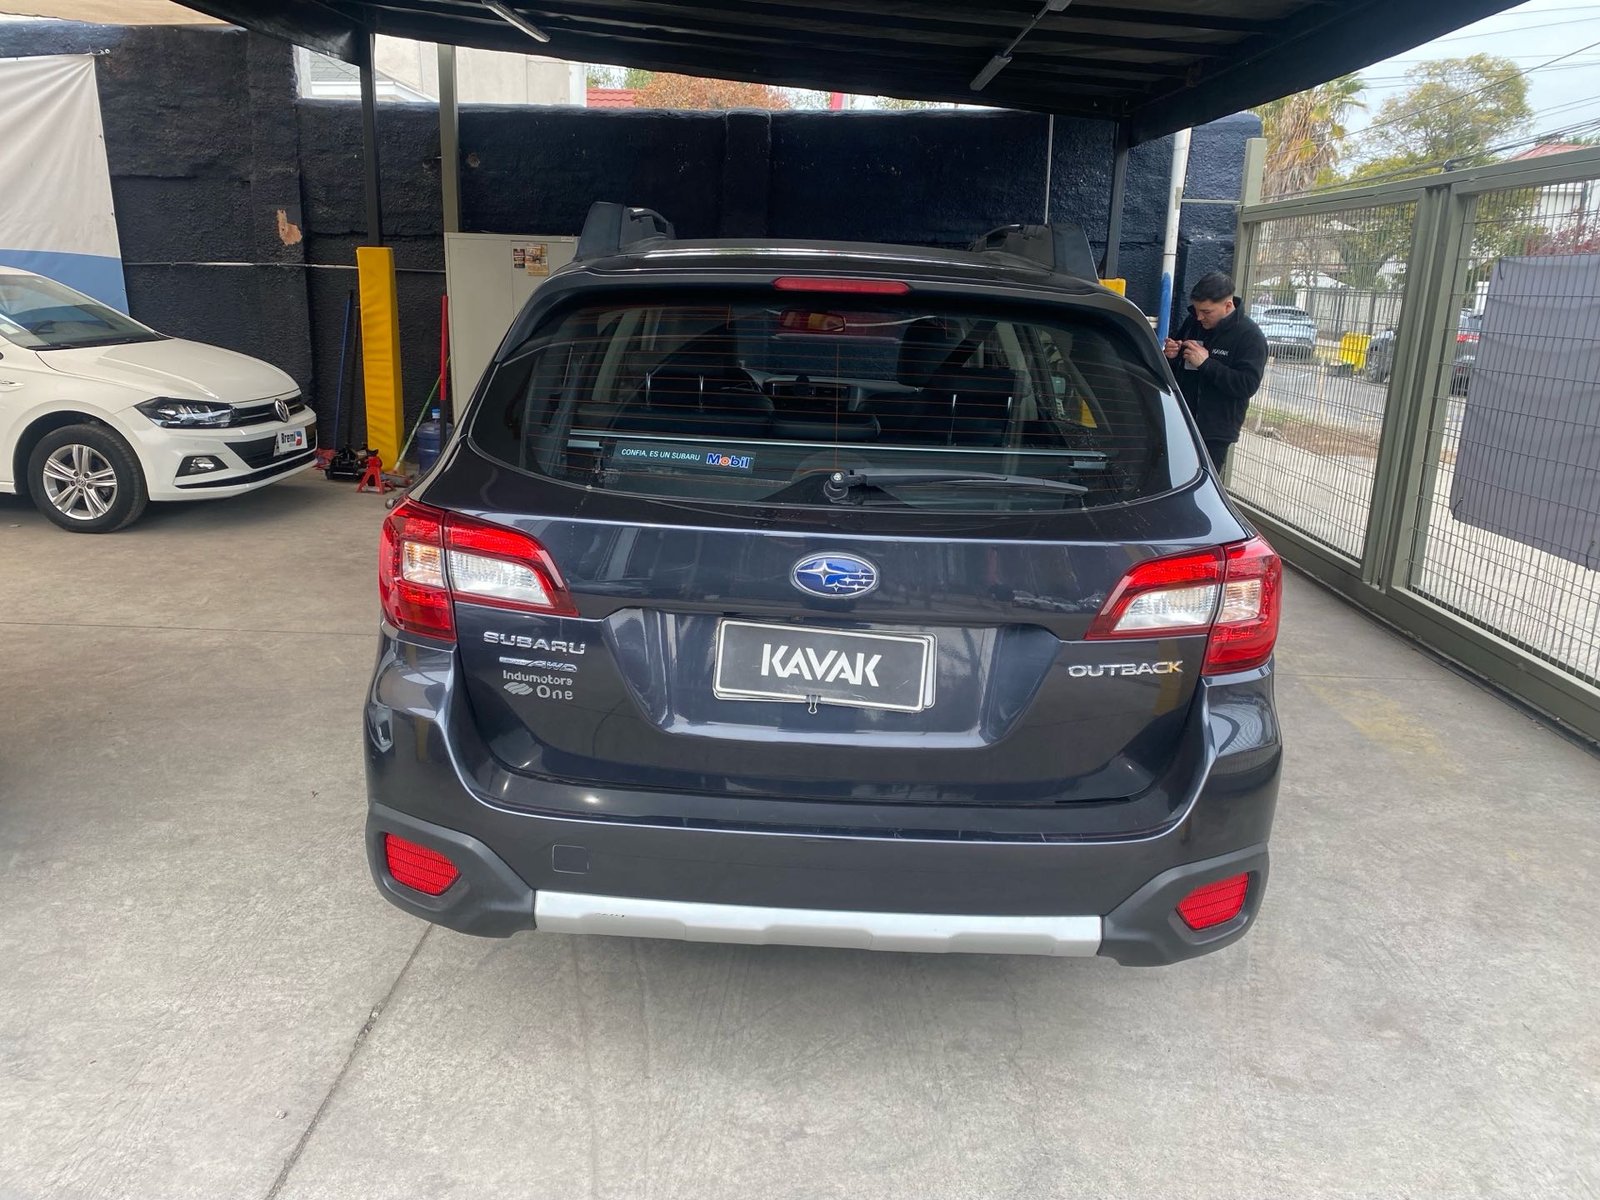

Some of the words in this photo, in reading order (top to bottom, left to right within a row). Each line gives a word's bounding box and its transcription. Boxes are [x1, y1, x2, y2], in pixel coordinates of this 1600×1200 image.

[621, 448, 648, 458] CONFIA,
[649, 450, 659, 459] ES
[660, 451, 671, 459] UN
[671, 452, 701, 461] SUBARU
[706, 452, 750, 469] Mobil
[483, 631, 586, 655] SUBARU
[760, 643, 882, 687] KAVAK
[1067, 660, 1184, 678] OUTBACK
[502, 669, 573, 686] Indumotors
[536, 684, 573, 700] One
